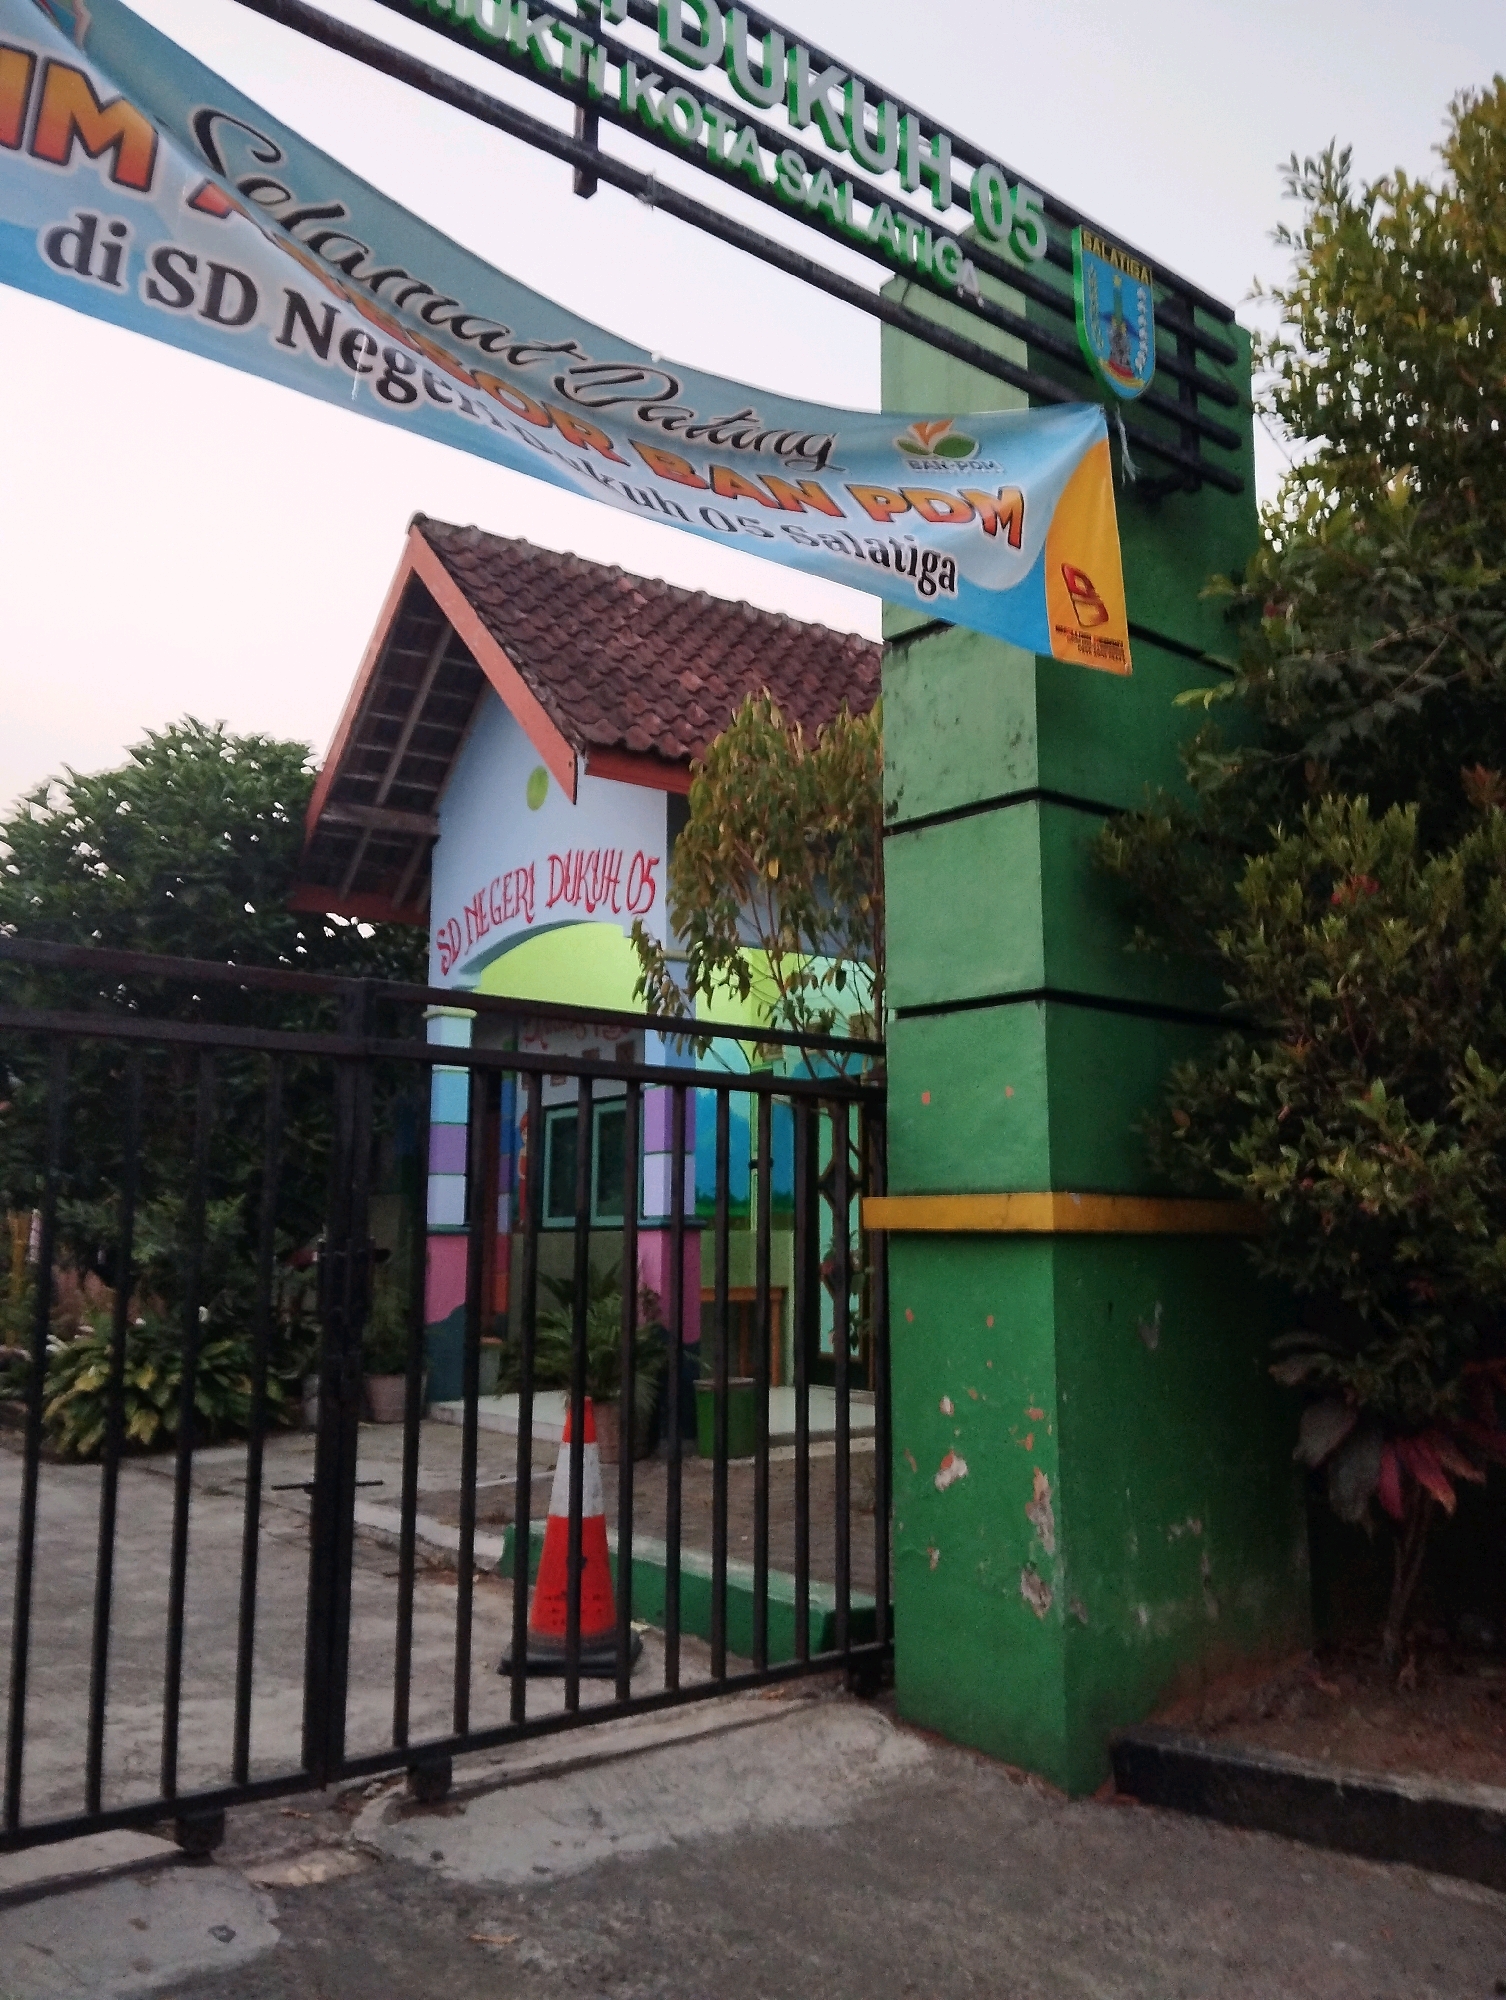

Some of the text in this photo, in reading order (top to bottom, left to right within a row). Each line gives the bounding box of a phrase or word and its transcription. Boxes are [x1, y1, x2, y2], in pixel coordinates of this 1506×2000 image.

[619, 60, 763, 185] KOTA
[773, 147, 984, 308] SALATIGA
[657, 0, 1048, 262] DUKUH 05
[1082, 230, 1150, 286] SALATIGA
[44, 212, 122, 287] di
[146, 245, 258, 326] SD
[699, 505, 775, 539] 05
[780, 523, 956, 598] Salatiga
[628, 438, 847, 518] BAN
[843, 483, 1024, 550] PDM
[436, 847, 660, 977] SD NEGERI DUKUH 05
